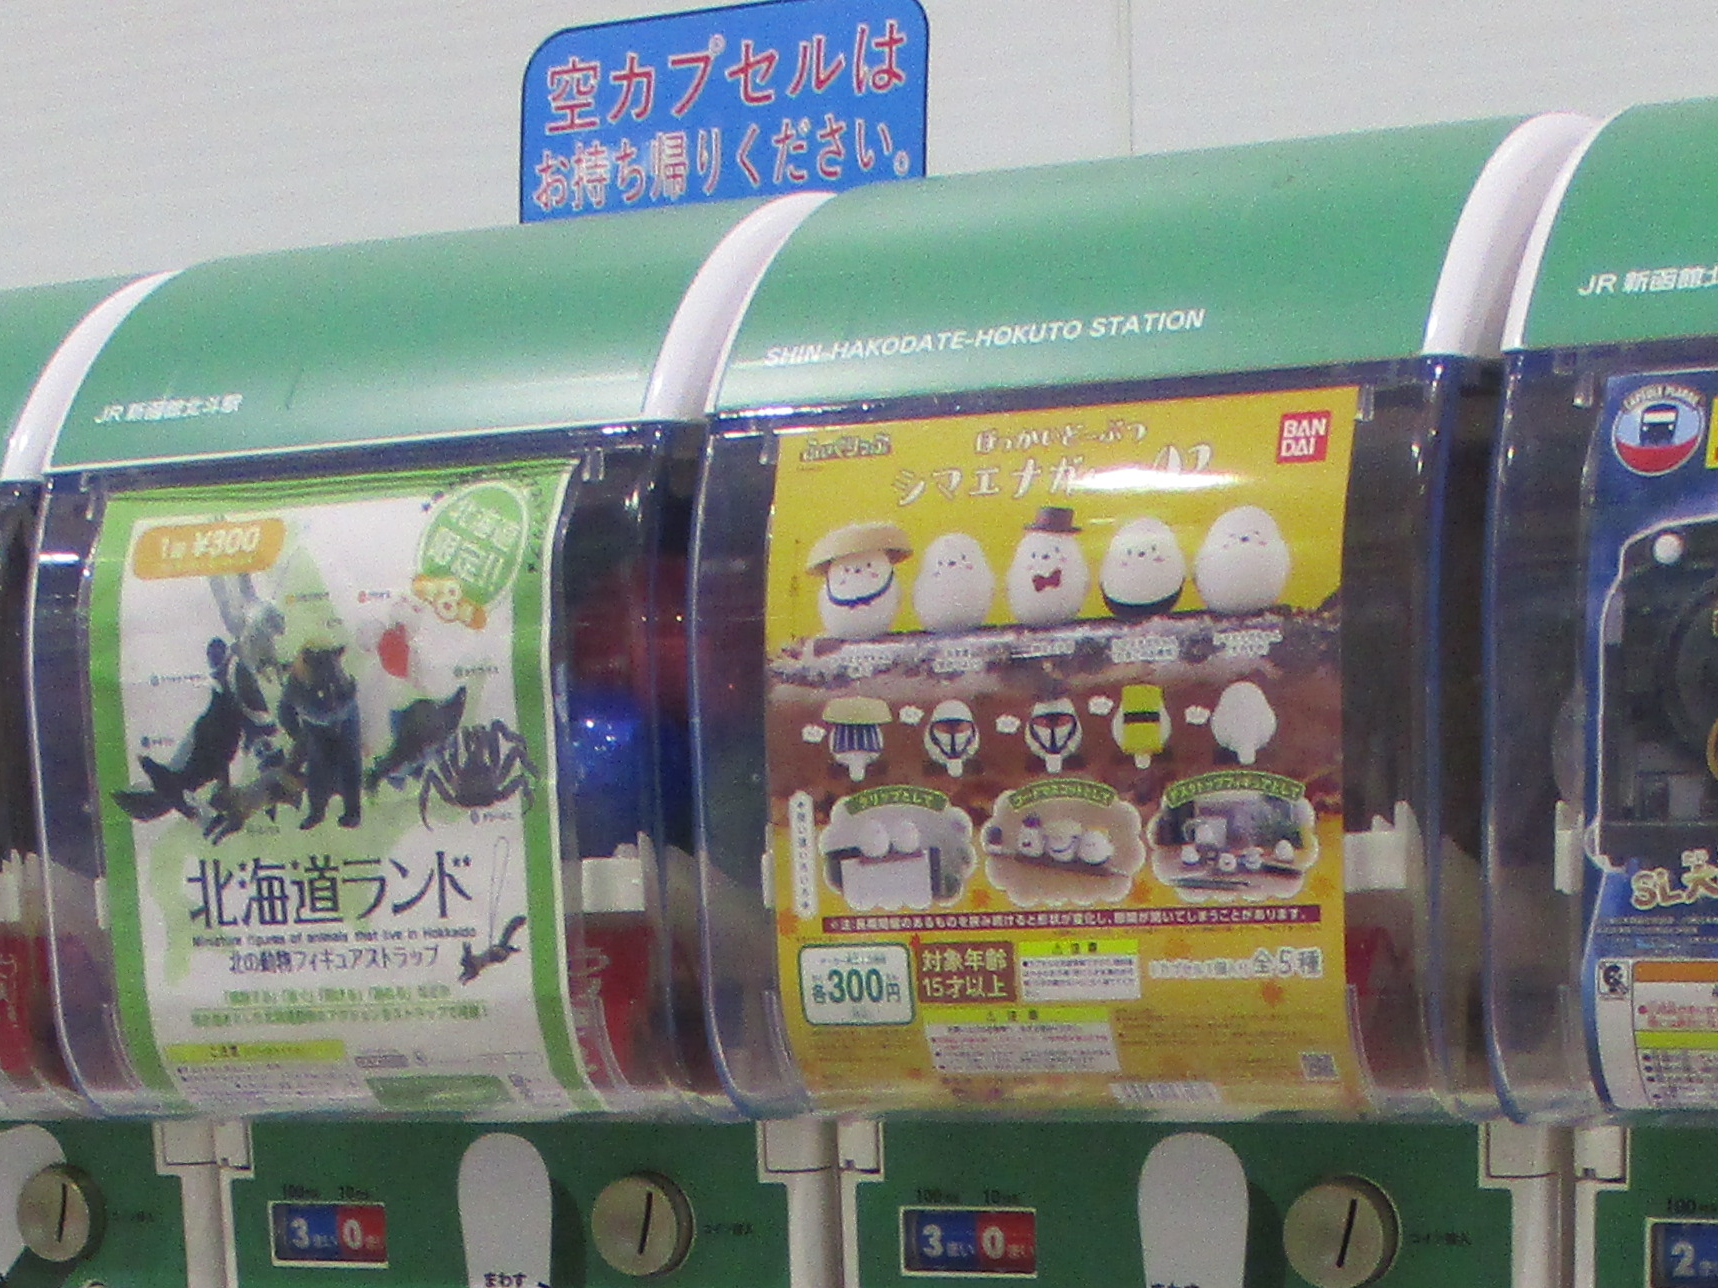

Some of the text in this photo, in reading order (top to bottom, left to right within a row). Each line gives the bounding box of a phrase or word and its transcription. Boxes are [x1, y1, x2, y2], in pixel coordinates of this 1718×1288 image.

[546, 19, 907, 135] 空カプセルは
[534, 113, 912, 211] お持ち帰りください。
[1577, 273, 1618, 297] JR
[764, 308, 1205, 366] SHIN-HAKODATE-HOKUTO STATION
[1281, 417, 1327, 438] BAN
[1279, 437, 1317, 458] DAI
[186, 849, 473, 929] 北海道ランド
[921, 947, 1009, 973] 対象年齢
[921, 974, 1008, 999] 15才以上
